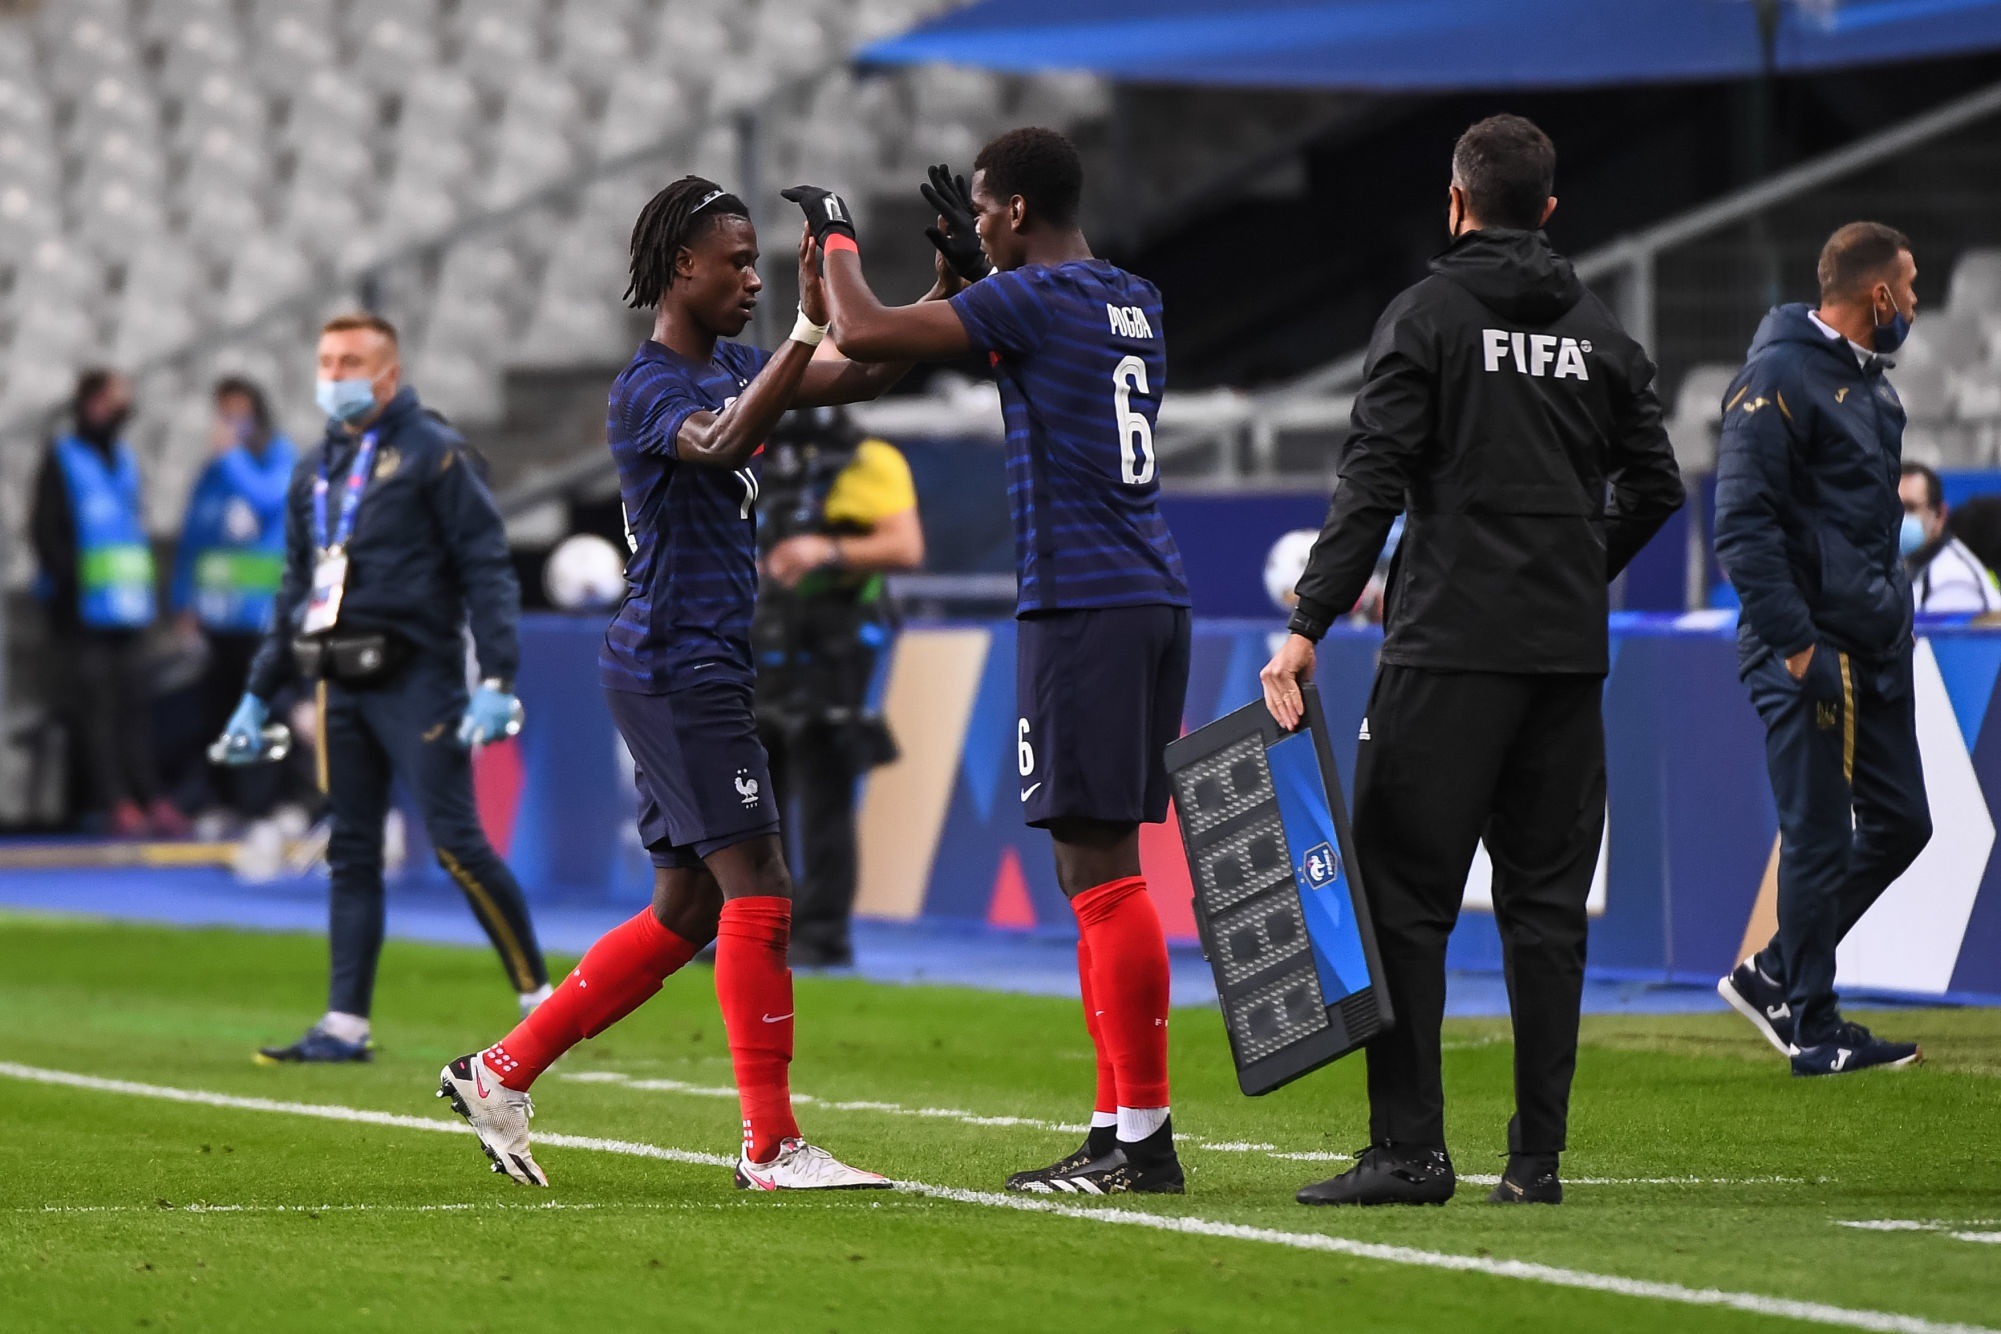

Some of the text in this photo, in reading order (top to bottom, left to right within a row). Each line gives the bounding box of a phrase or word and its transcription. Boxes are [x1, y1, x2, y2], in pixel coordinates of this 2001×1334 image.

[1106, 303, 1154, 339] POGBA
[1482, 328, 1590, 381] FIFA
[1112, 355, 1155, 485] 6
[1018, 717, 1035, 776] 6
